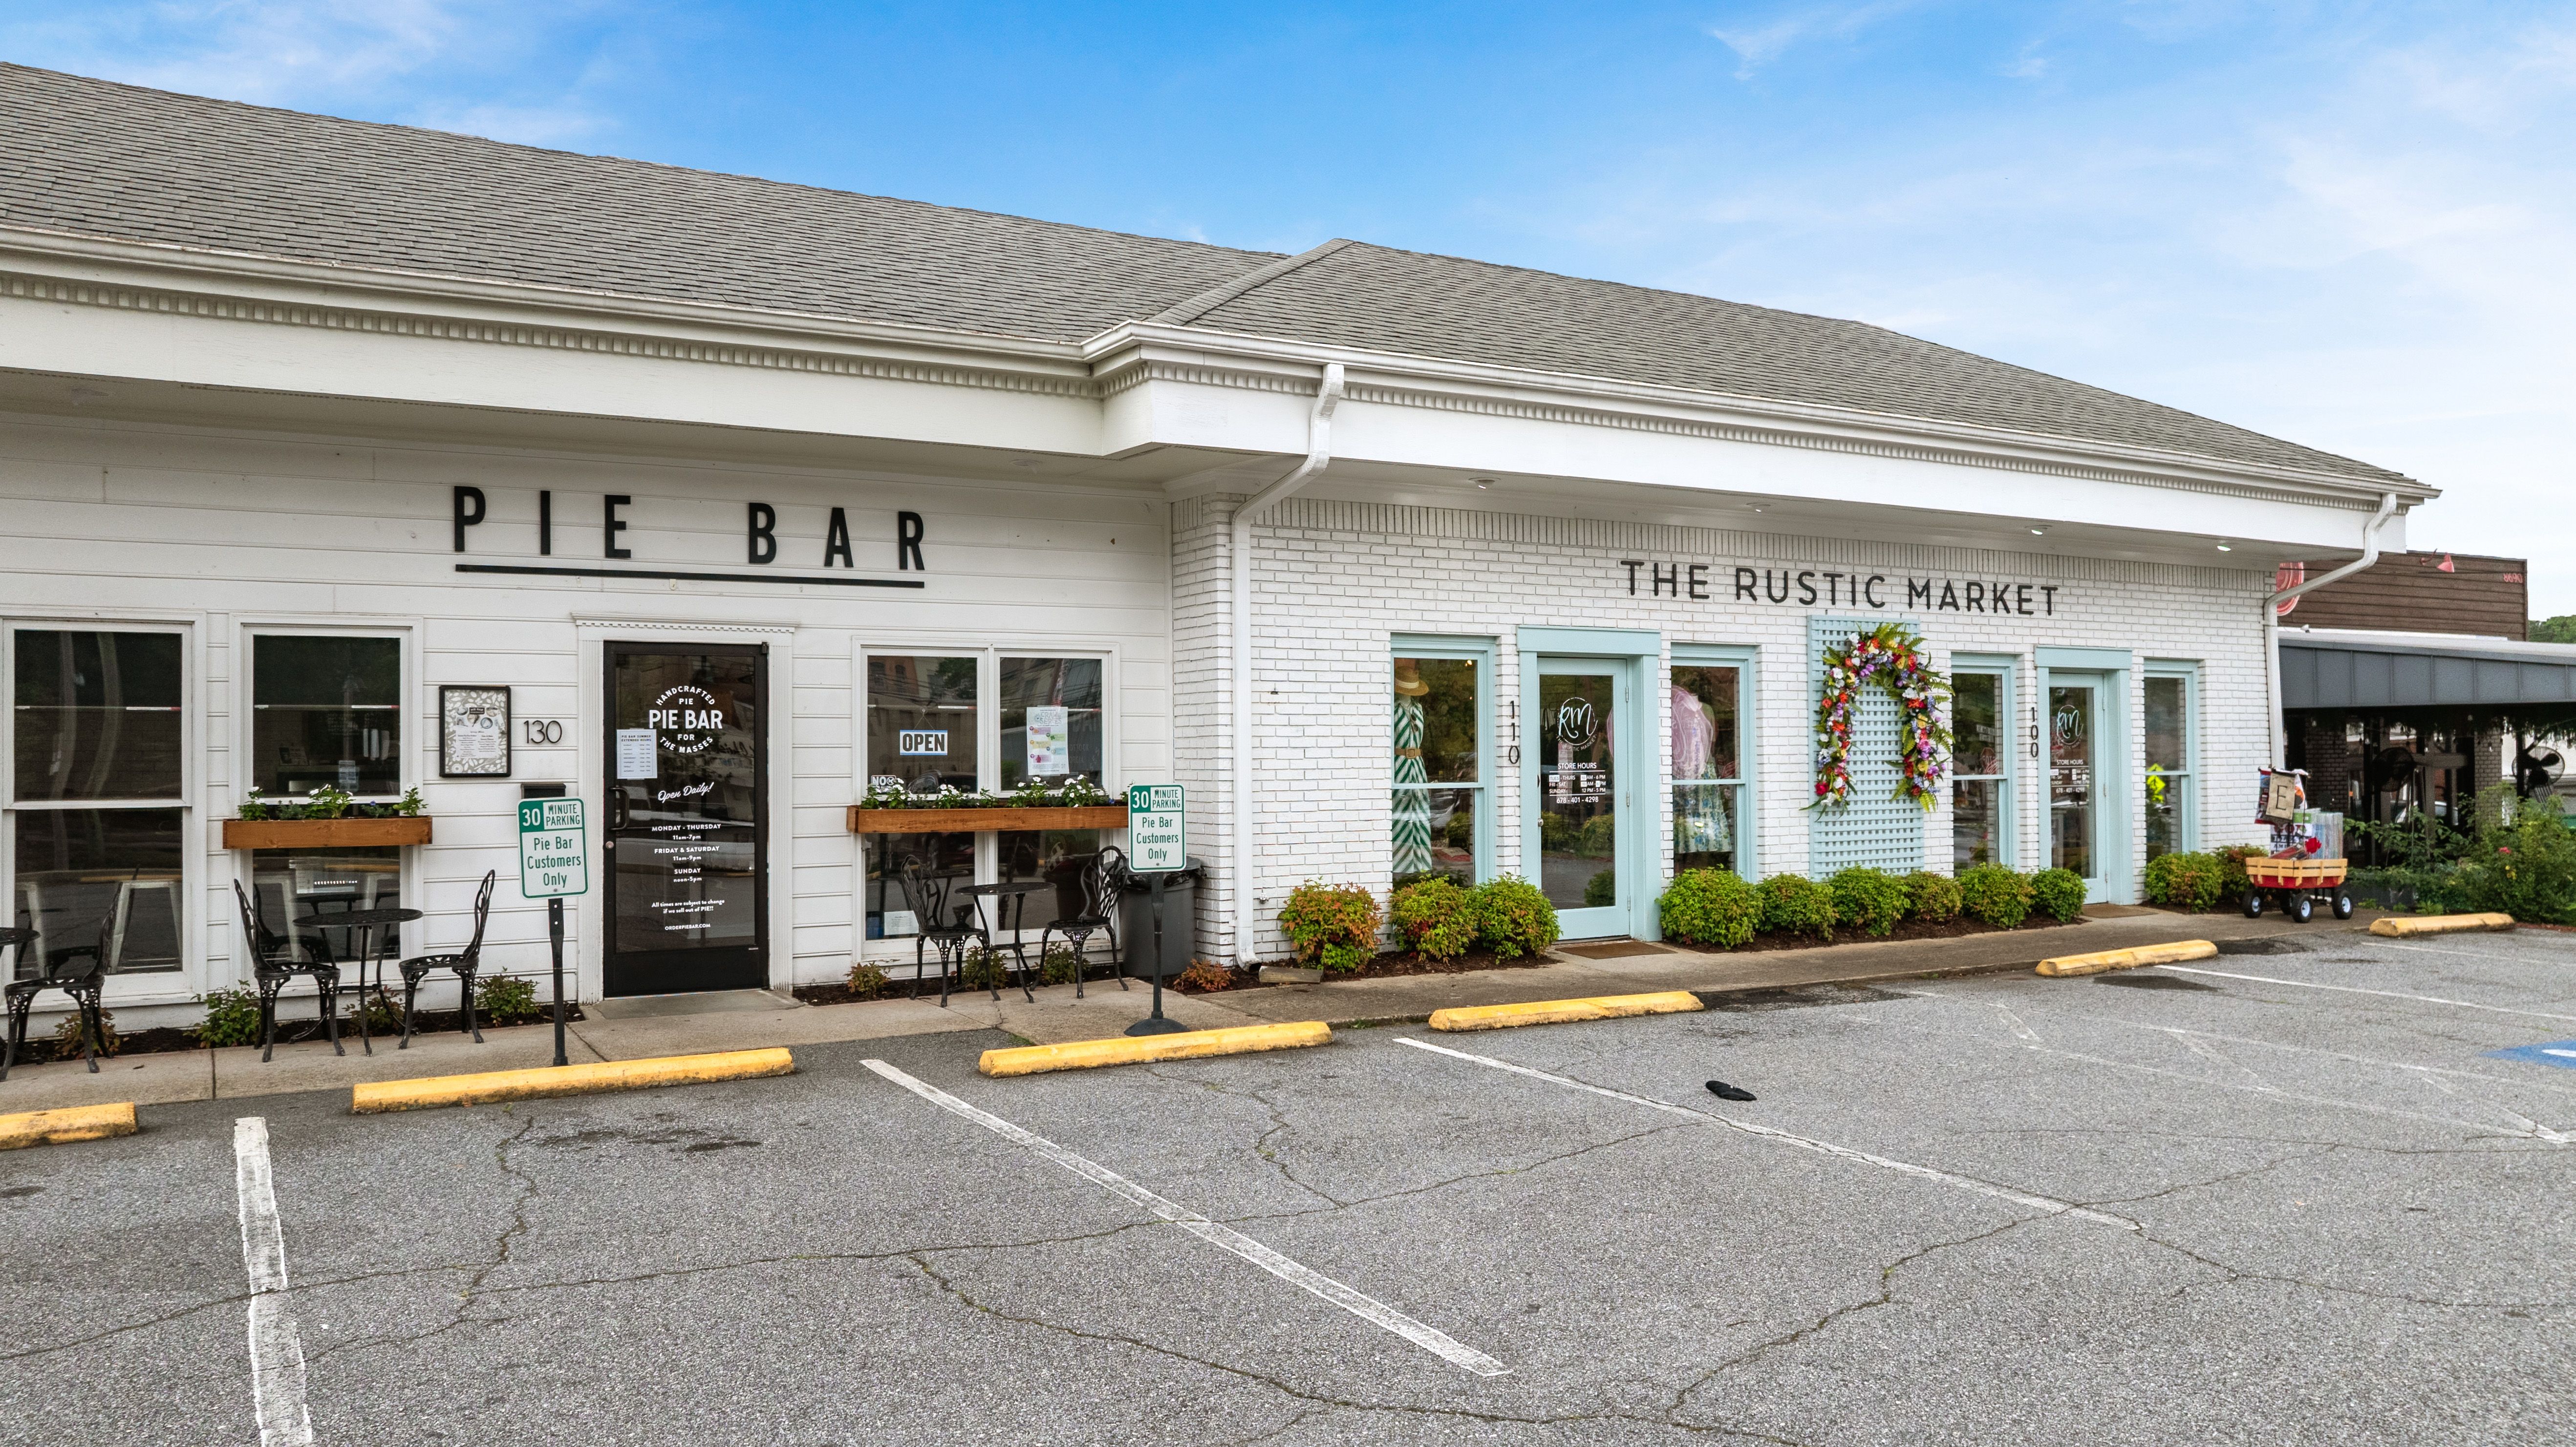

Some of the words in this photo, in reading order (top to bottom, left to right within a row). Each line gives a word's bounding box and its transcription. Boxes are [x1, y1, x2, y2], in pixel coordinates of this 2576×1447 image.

[453, 485, 631, 560] PIE
[747, 502, 925, 570] BAR
[1620, 560, 1710, 600] THE
[1735, 567, 1886, 609] RUSTIC
[1908, 577, 2059, 616] MARKET
[656, 686, 715, 705] HANDCRAFTED
[649, 709, 678, 729] PIE
[685, 709, 723, 729] BAR
[523, 720, 562, 744] 130
[660, 737, 676, 751] THE
[679, 736, 713, 753] MASSES
[902, 733, 945, 752] OPEN
[872, 776, 886, 786] NO
[658, 790, 681, 803] Open
[683, 782, 714, 796] Daily!
[1132, 791, 1149, 809] 30
[1155, 789, 1178, 799] MINUTE
[2275, 785, 2288, 810] E
[548, 804, 578, 815] MINUTE
[1152, 799, 1181, 809] PARKING
[522, 808, 541, 827] 30
[546, 814, 580, 827] PARKING
[1142, 816, 1155, 828] Pie
[1159, 816, 1173, 828] Bar
[534, 837, 550, 851] Pie
[555, 836, 573, 850] Bar
[1136, 832, 1179, 844] Customers
[527, 855, 581, 869] Customers
[1148, 848, 1167, 861] Only
[543, 872, 567, 888] Only
